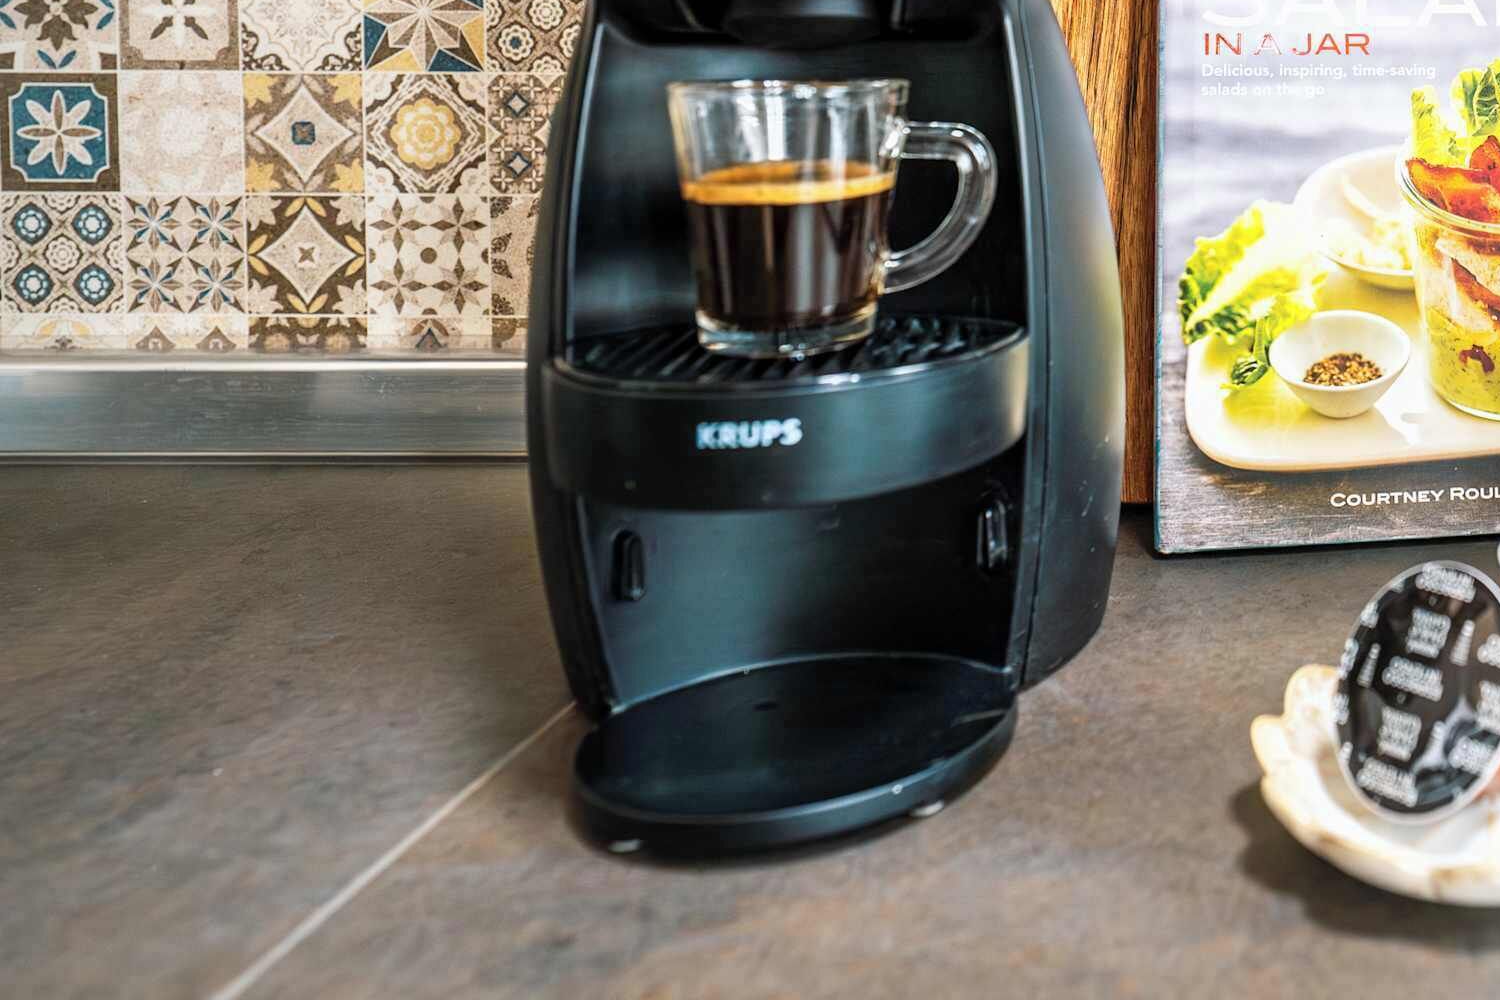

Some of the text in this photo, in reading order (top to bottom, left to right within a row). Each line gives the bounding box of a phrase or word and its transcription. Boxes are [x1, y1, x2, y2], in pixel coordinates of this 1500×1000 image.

[1203, 32, 1371, 56] IN A JAR
[1201, 63, 1436, 80] Delicious, inspiring, time-saving
[1201, 81, 1325, 98] salads on th go
[696, 417, 803, 449] KRUPS
